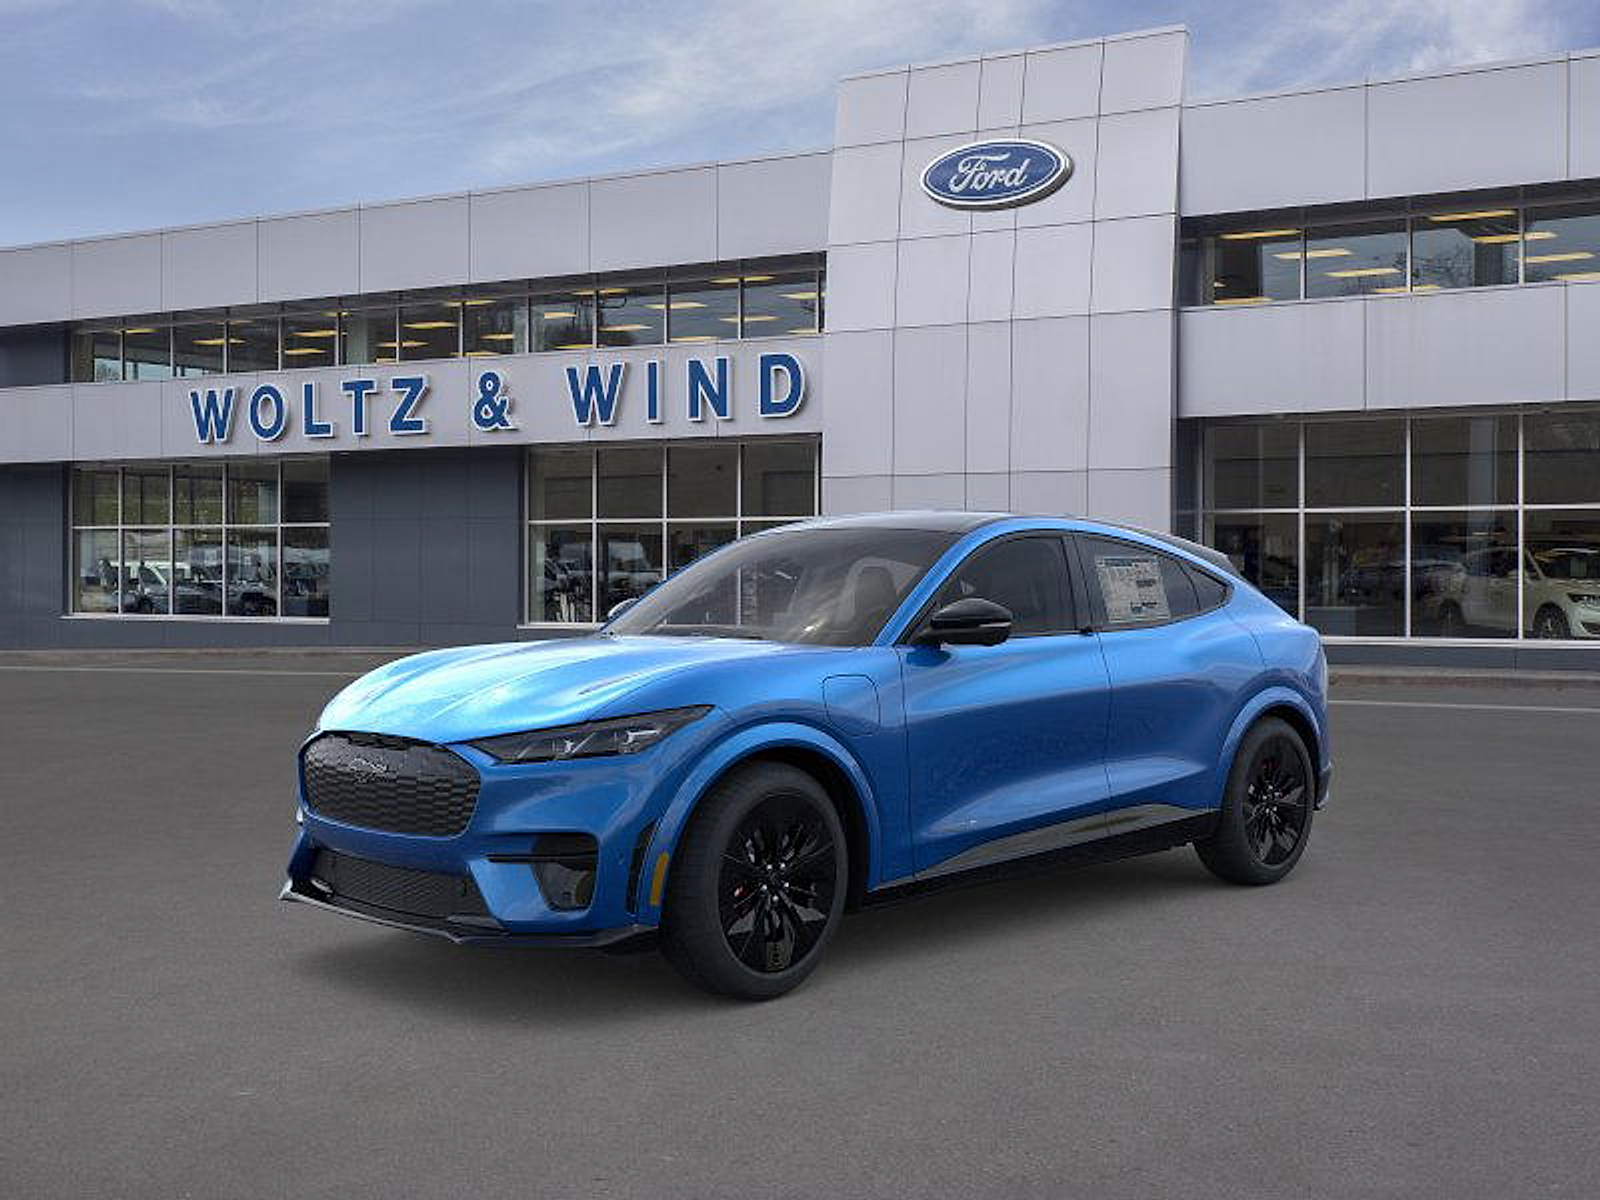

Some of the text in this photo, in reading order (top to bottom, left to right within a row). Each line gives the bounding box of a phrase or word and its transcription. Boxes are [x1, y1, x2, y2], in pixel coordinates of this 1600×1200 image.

[950, 152, 1031, 193] Ford
[190, 352, 806, 443] WOLTZ & WIND
